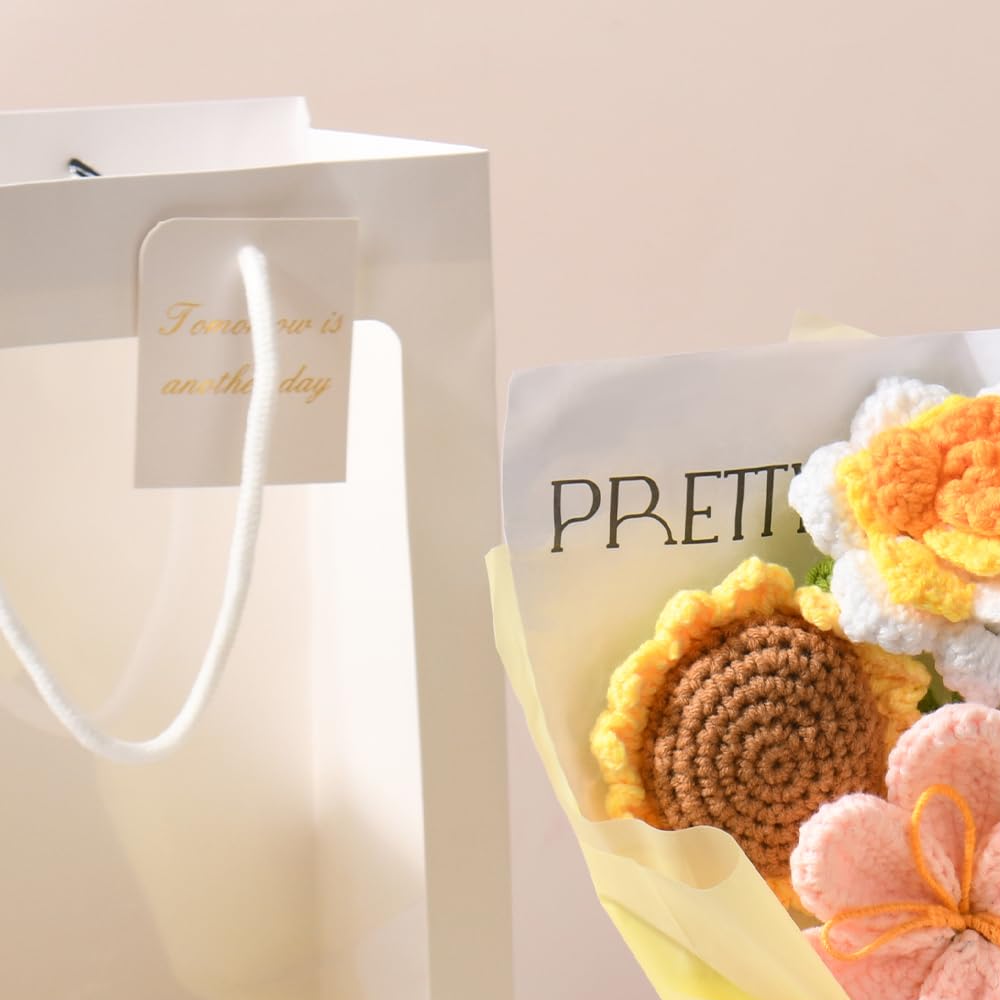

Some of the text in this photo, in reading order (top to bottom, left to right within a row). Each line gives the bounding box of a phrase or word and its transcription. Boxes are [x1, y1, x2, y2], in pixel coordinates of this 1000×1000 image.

[159, 301, 345, 336] Tomoow is
[160, 362, 333, 404] anothe day
[551, 463, 807, 553] PRETT
